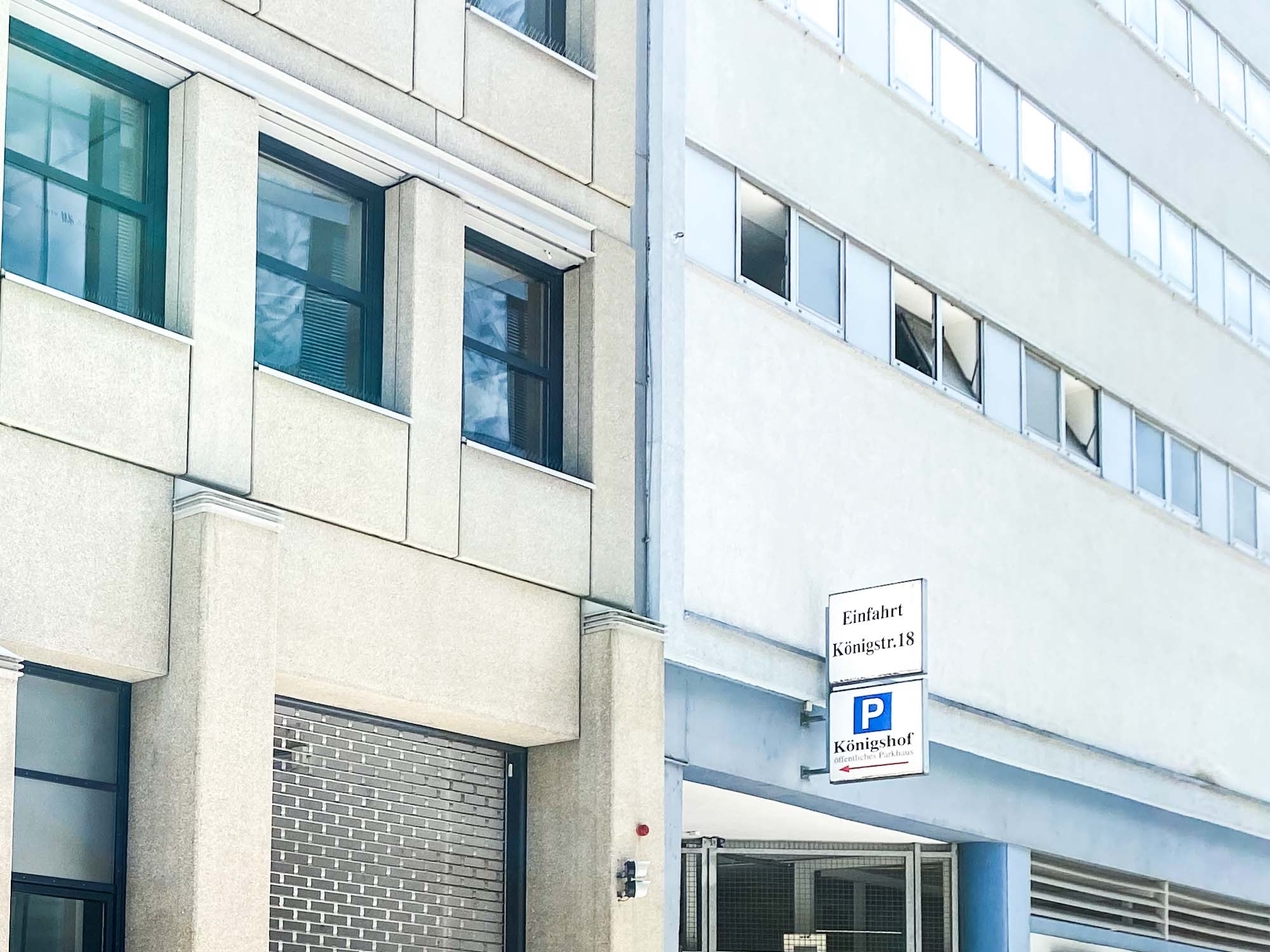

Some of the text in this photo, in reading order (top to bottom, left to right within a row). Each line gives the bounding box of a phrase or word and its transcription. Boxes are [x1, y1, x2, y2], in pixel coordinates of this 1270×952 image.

[843, 604, 903, 625] Einfahrt
[833, 631, 914, 657] Königstr.18
[861, 698, 885, 729] P
[834, 732, 915, 753] Königshof
[834, 748, 914, 764] öffentliches Parkhaus
